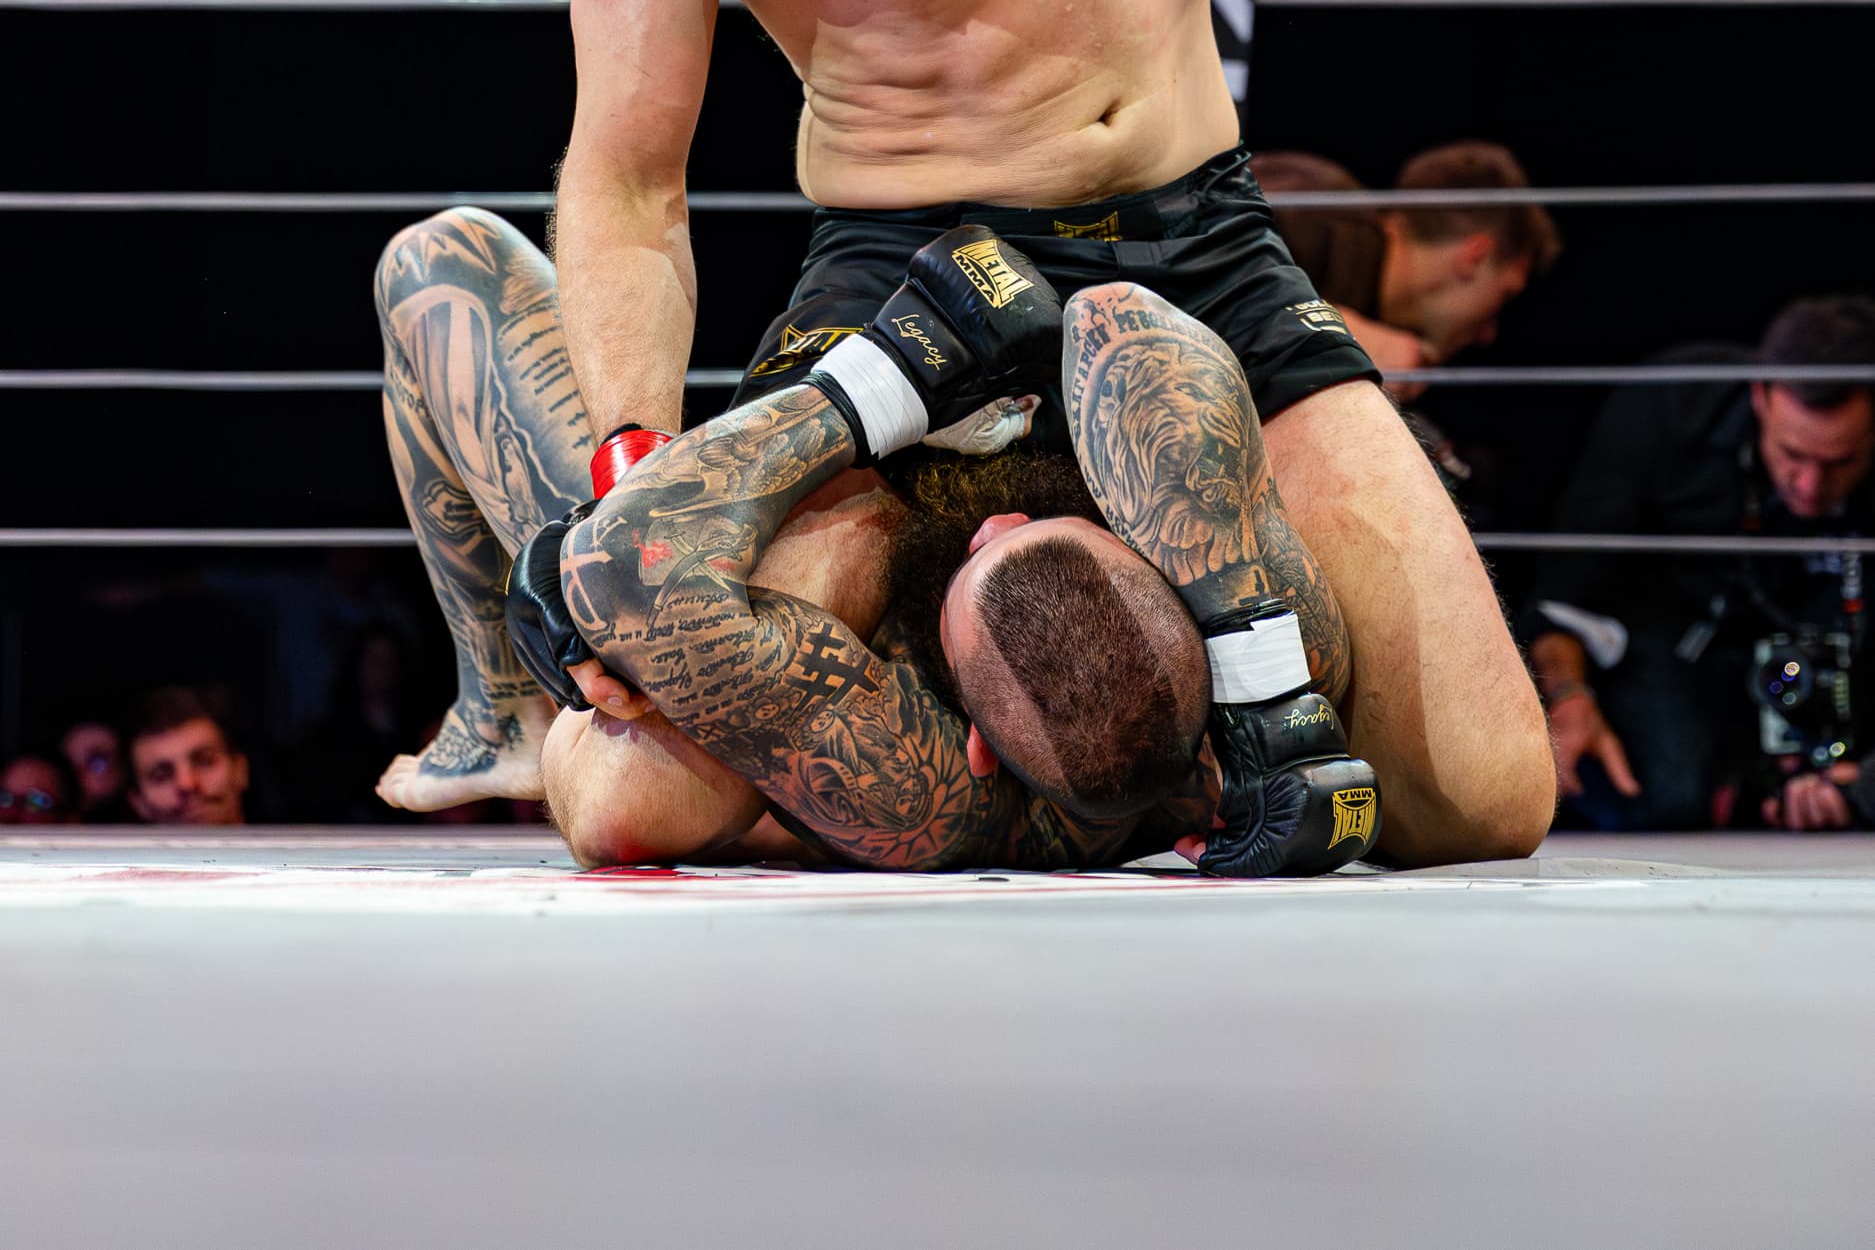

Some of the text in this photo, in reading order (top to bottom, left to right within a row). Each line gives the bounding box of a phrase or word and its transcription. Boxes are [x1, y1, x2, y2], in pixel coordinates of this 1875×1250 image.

[954, 253, 997, 305] MMA
[955, 239, 1034, 309] METAL
[891, 313, 948, 370] Legacy
[1285, 703, 1335, 729] Legacy
[1337, 789, 1373, 801] MMA
[1328, 798, 1376, 849] METAL
